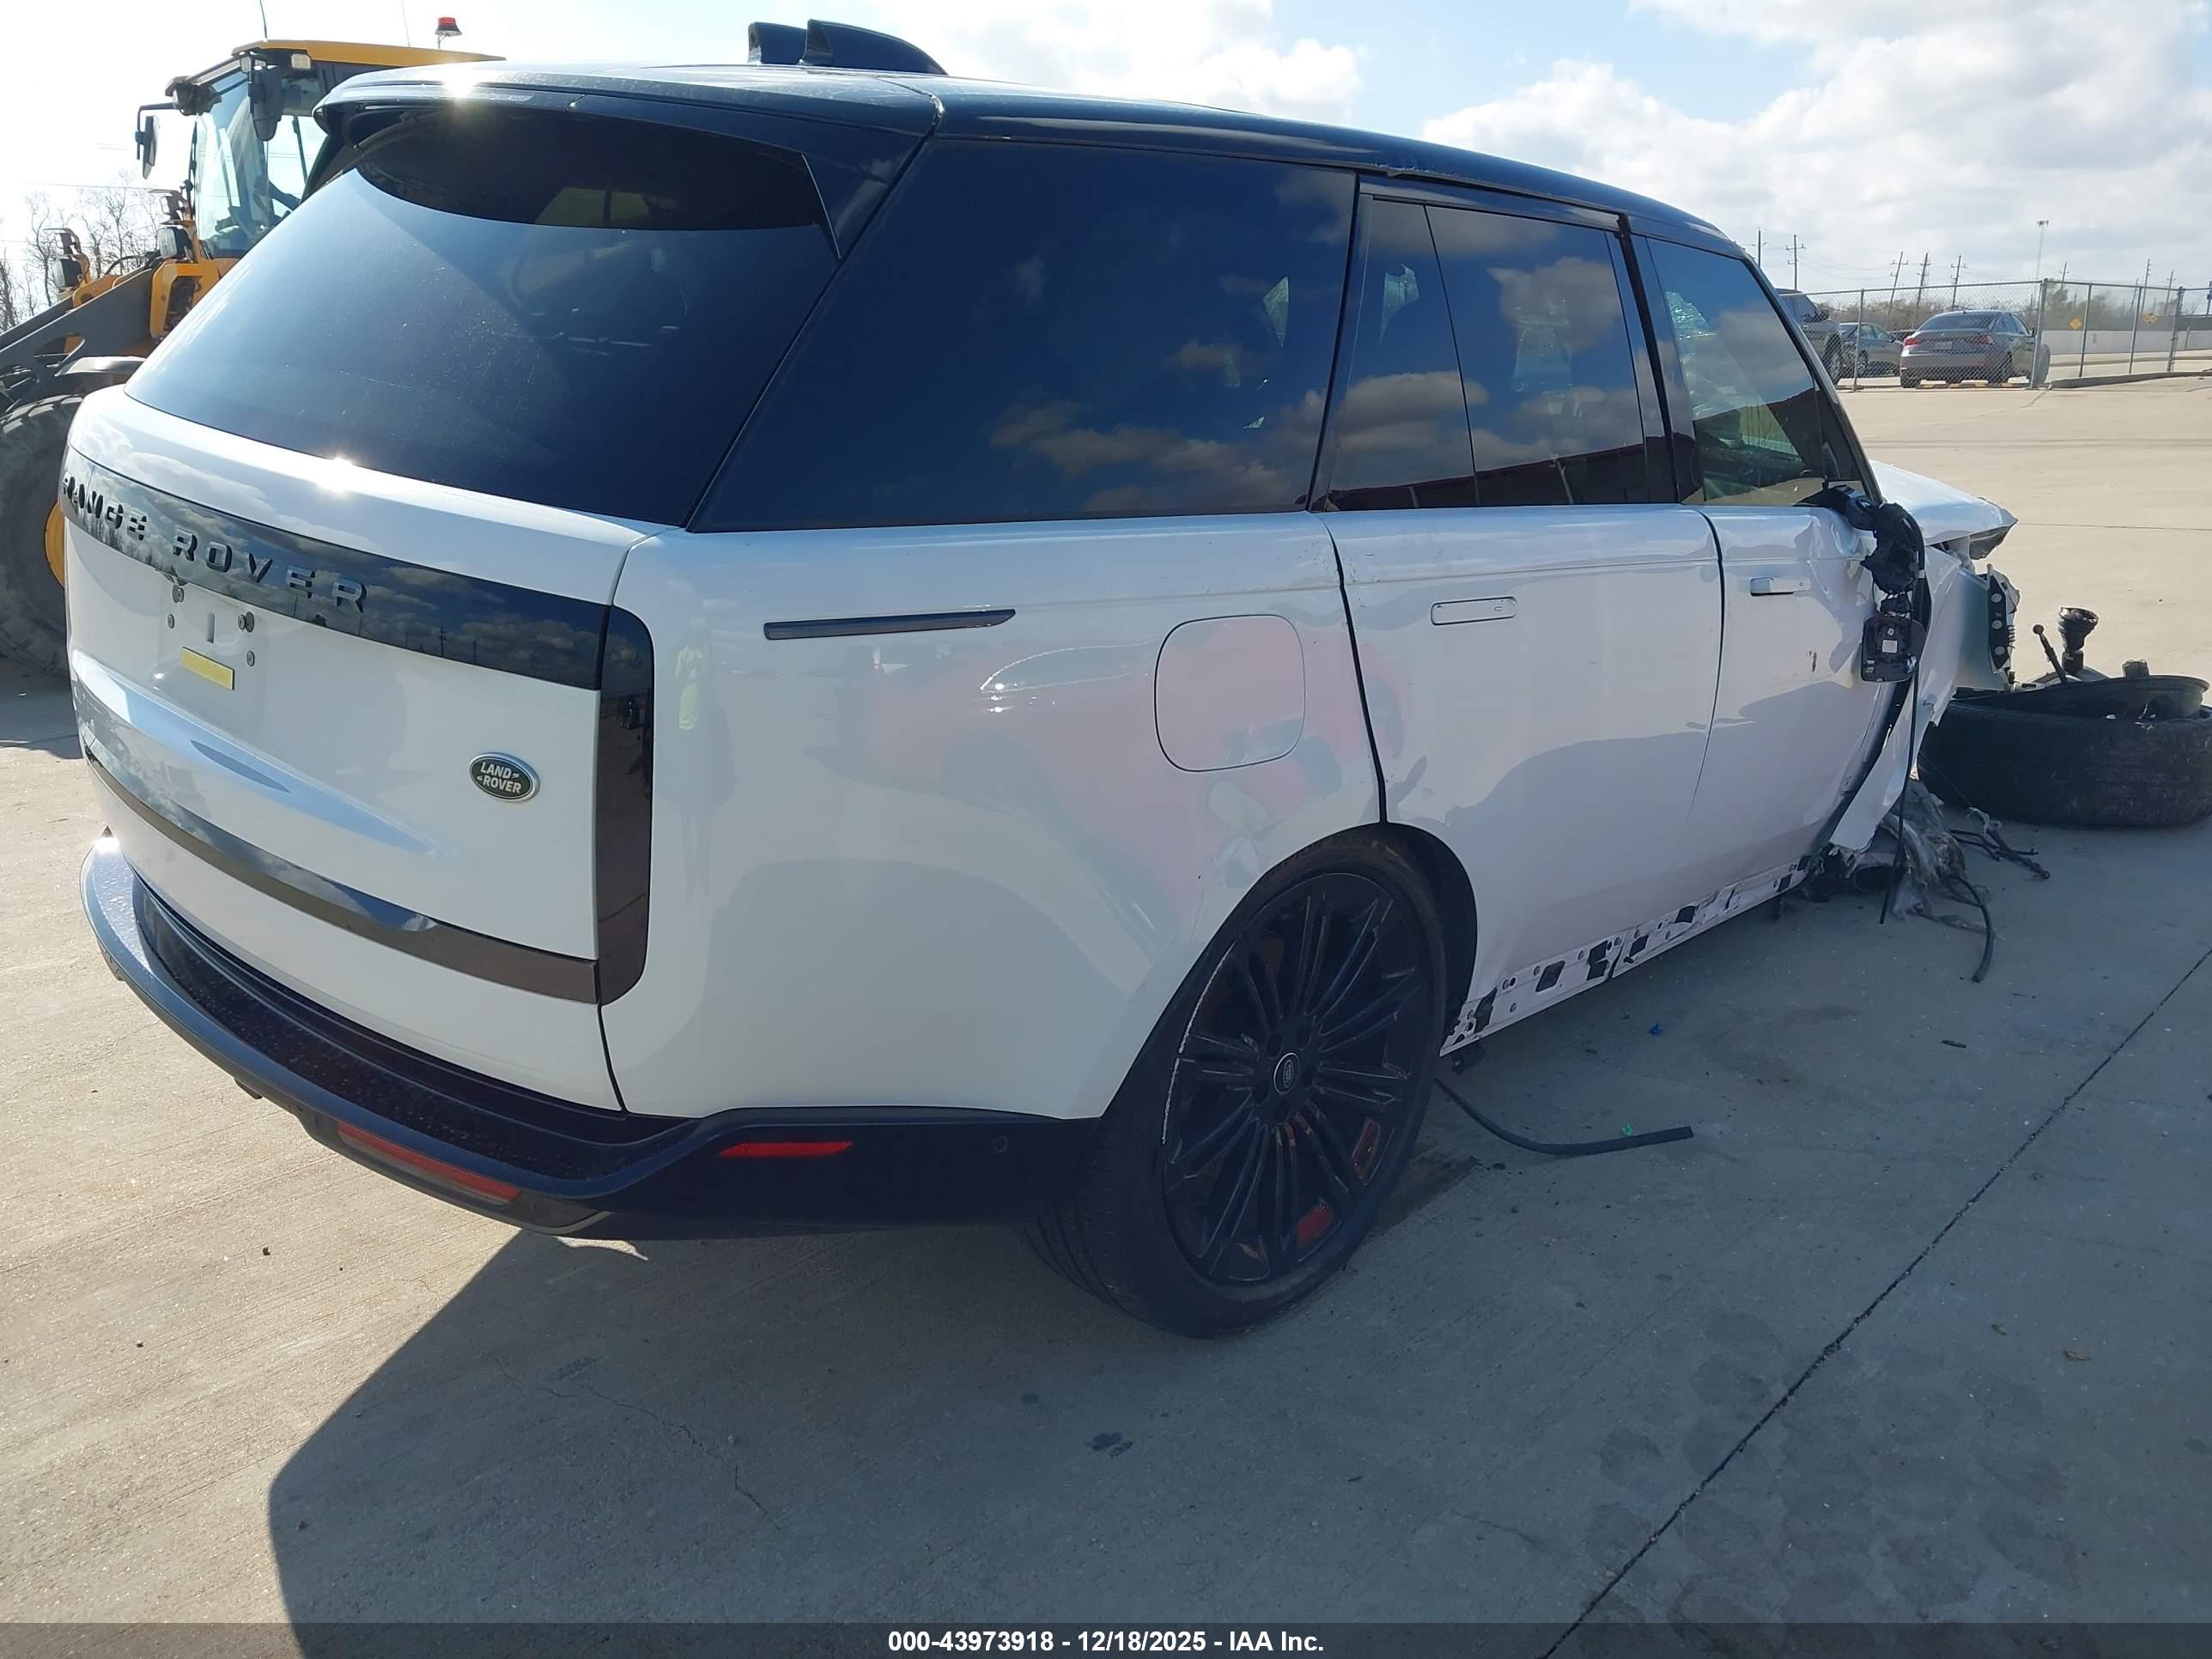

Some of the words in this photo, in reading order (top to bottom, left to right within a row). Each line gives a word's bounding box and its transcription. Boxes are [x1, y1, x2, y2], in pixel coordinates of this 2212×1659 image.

[63, 471, 147, 541] RANGE
[173, 528, 368, 613] ROVER
[480, 762, 513, 779] LAND
[483, 775, 522, 793] ROVER
